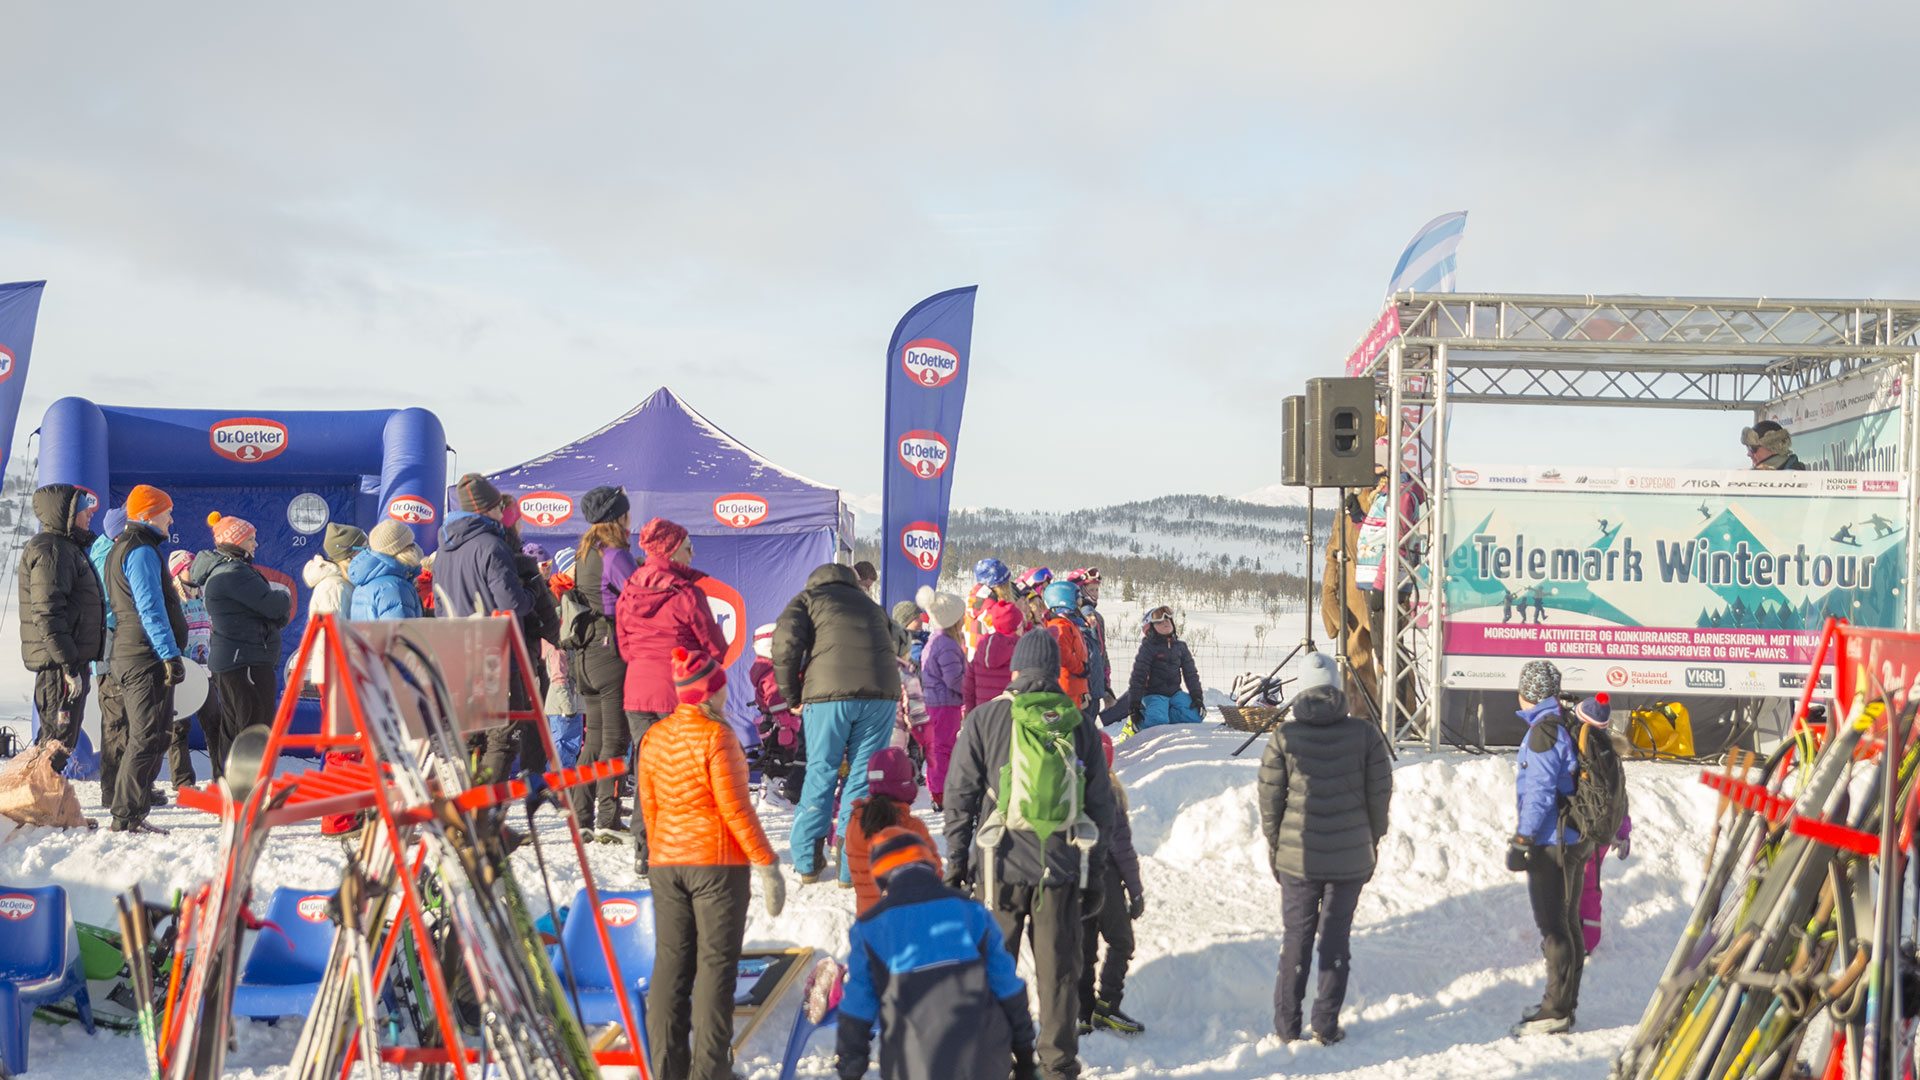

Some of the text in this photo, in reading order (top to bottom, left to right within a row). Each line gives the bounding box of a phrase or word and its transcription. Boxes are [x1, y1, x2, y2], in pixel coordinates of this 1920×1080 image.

[907, 351, 956, 370] Dr.Oetker
[217, 430, 282, 443] Dr.Oetker
[1489, 475, 1528, 484] mentos
[1639, 477, 1676, 489] ESPEGARD
[1727, 481, 1809, 489] PACKLINE
[392, 503, 433, 518] Dr.Oetker
[522, 501, 569, 512] Dr.Oetker
[718, 503, 765, 513] Dr.Oetker
[292, 535, 307, 546] 20
[1474, 533, 1644, 582] Telemark
[1655, 538, 1876, 589] Wintertour
[1483, 627, 1538, 640] MORSOMME
[1539, 628, 1599, 642] AKTIVITETER
[1599, 630, 1612, 642] OG
[1614, 631, 1691, 644] KONKURRANSER.
[1693, 632, 1768, 646] BARNESKIRENN.
[1769, 634, 1790, 647] MØT
[1544, 642, 1790, 660] OG KNERTEN. GRATIS SMAKSPRØVER OG GIVE-AWAYS.
[1631, 670, 1668, 679] Rauland
[1631, 678, 1673, 686] Skisenter
